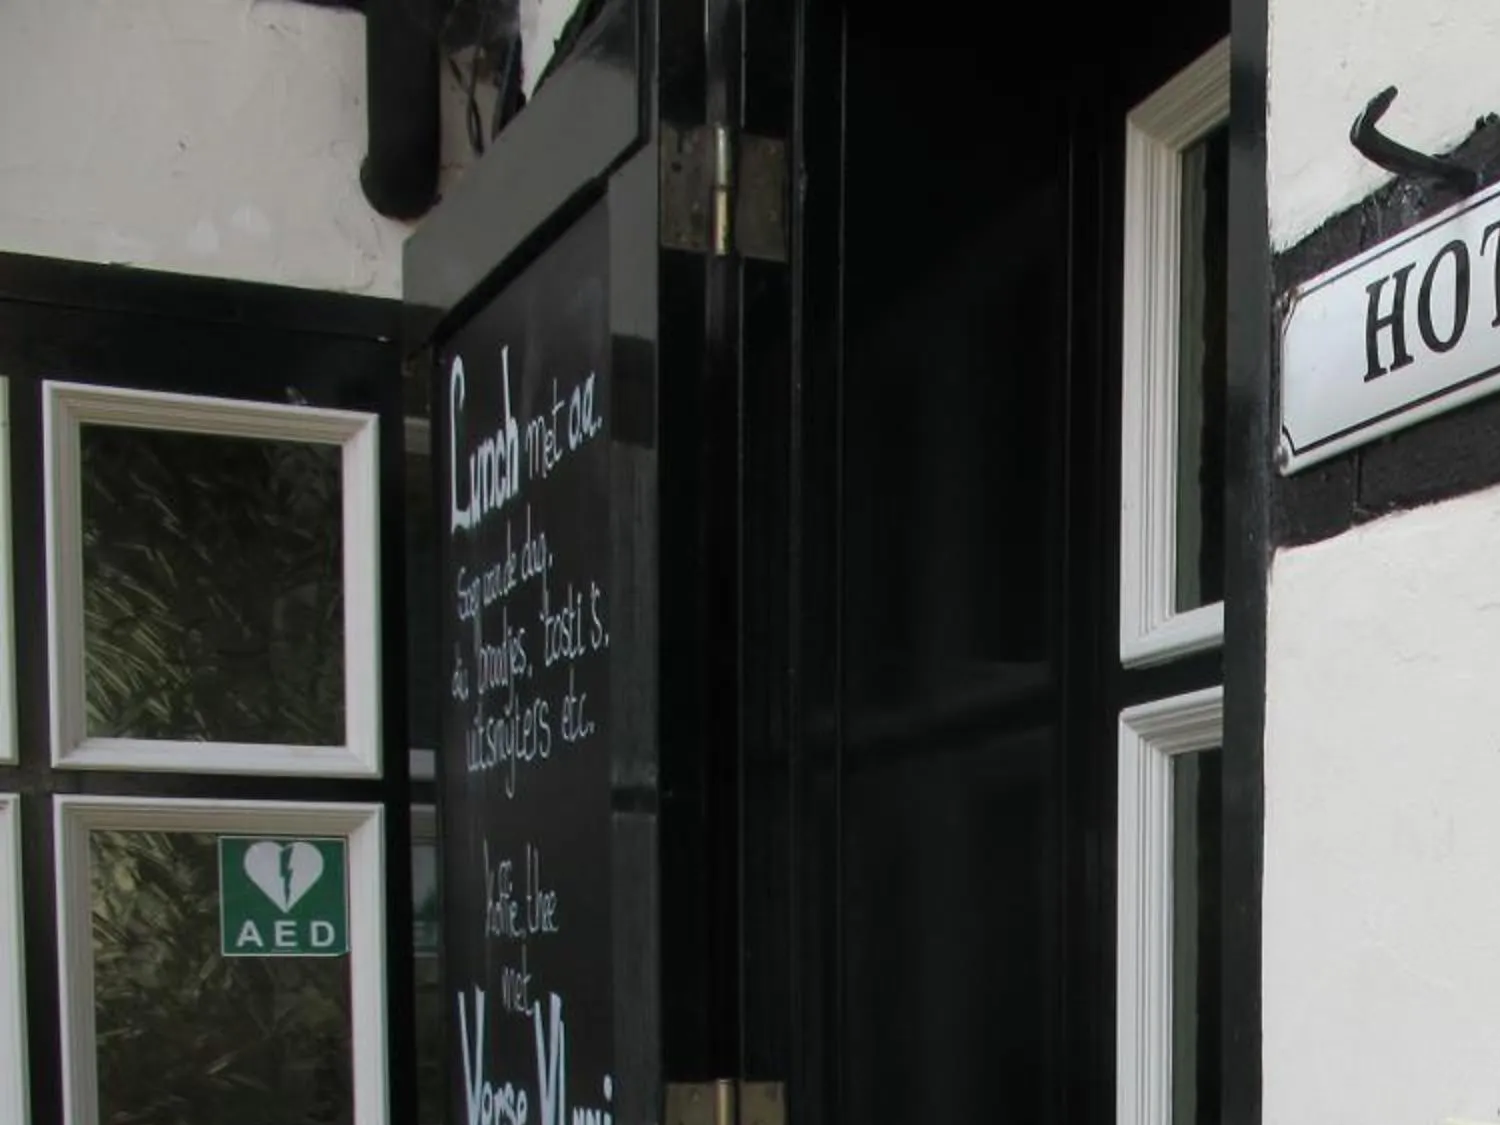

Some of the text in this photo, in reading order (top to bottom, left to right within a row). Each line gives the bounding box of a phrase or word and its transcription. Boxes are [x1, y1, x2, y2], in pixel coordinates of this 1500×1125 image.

[450, 344, 519, 535] Lunch
[525, 376, 566, 480] met
[561, 662, 595, 743] etc.
[235, 918, 336, 948] AED
[502, 943, 535, 1017] met
